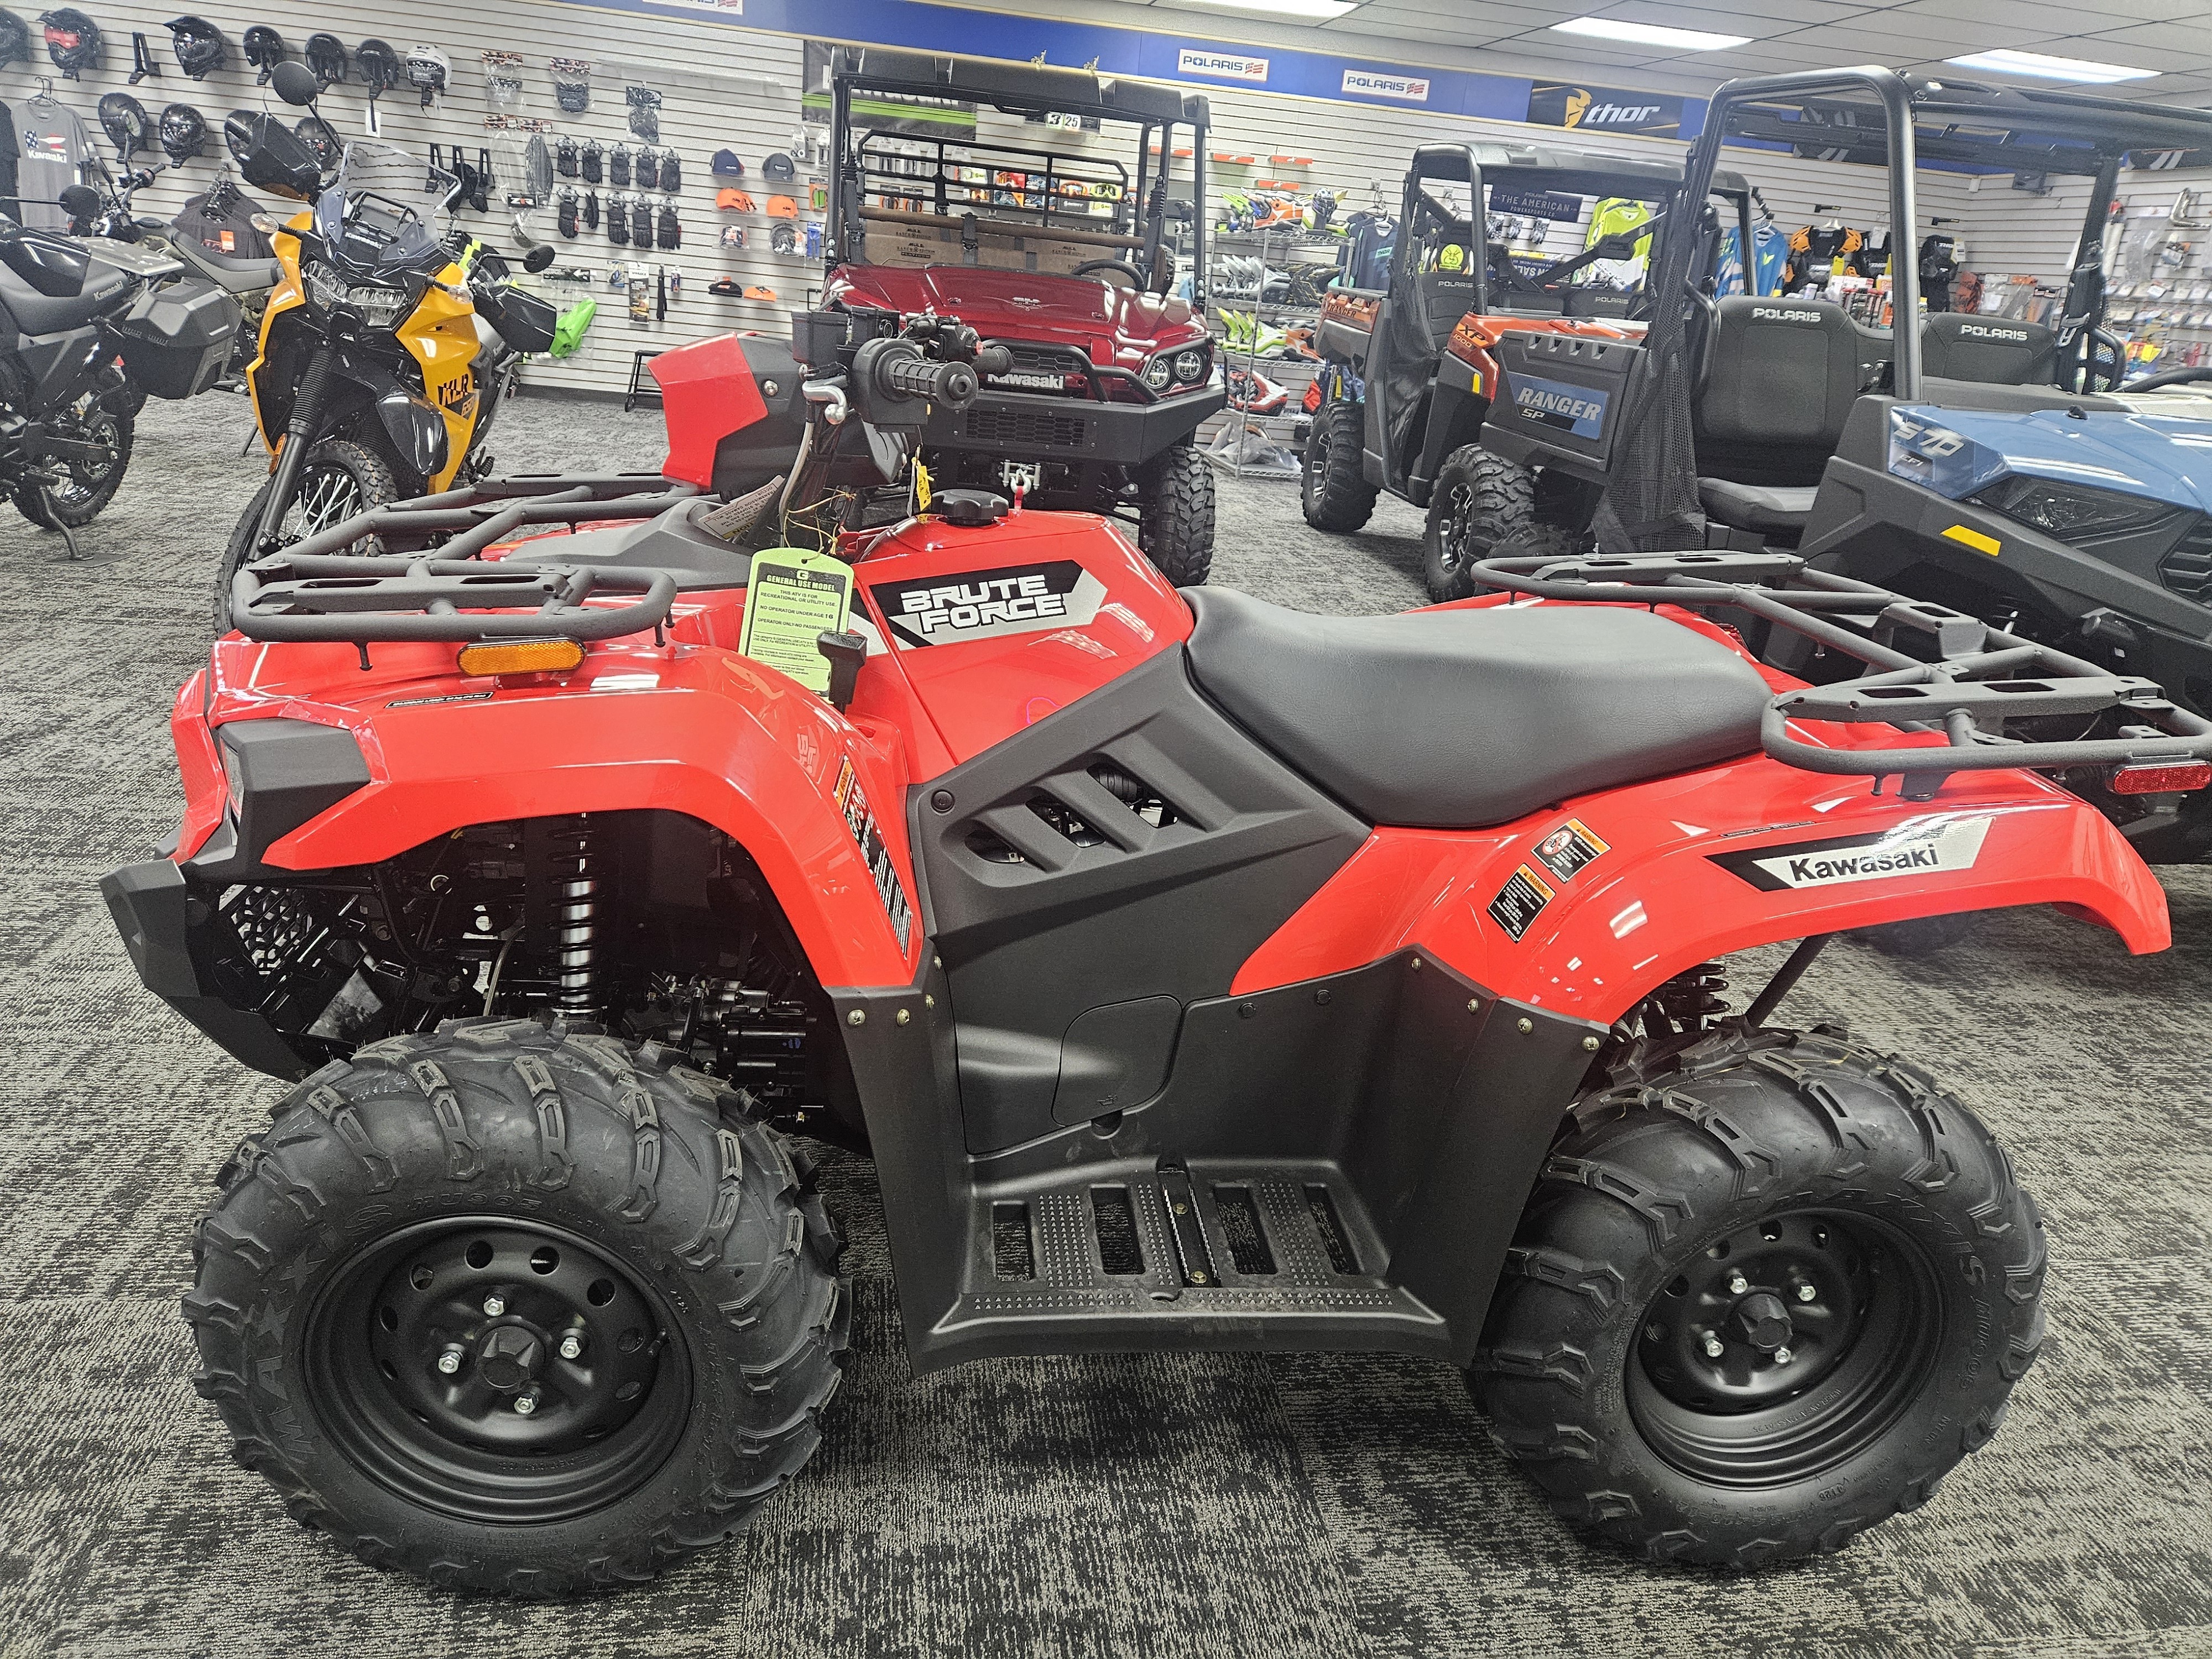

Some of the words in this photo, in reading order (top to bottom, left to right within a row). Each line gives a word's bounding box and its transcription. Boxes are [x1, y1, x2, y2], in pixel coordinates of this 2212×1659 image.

[1183, 55, 1244, 71] POLARIS
[1347, 75, 1404, 92] POLARIS
[1050, 114, 1061, 124] 3
[1585, 103, 1660, 123] thor
[1065, 116, 1078, 127] 25
[1502, 195, 1519, 204] THE
[1522, 198, 1570, 212] AMERICAN
[1511, 206, 1546, 216] POWERSPORTS
[93, 280, 124, 301] Kawasaki
[1330, 304, 1357, 318] RANGER
[1753, 307, 1821, 322] POLARIS
[1453, 333, 1472, 348] 1000
[1458, 324, 1486, 341] XP
[1961, 325, 2027, 341] POLARIS
[442, 373, 468, 406] KLR
[1517, 387, 1601, 421] RANGER
[1521, 408, 1545, 419] SP
[1893, 421, 1964, 456] 570
[1900, 454, 1924, 467] EFI
[726, 506, 743, 515] DAMAGE
[733, 506, 753, 517] STOPPED
[766, 574, 796, 586] GENERAL
[798, 580, 811, 588] USE
[812, 582, 835, 591] MODEL
[796, 570, 808, 580] G
[760, 592, 797, 602] RECREATIONAL
[900, 575, 1048, 613] BRUTE
[769, 606, 795, 614] OPERATOR
[920, 593, 1066, 634] FORCE
[1581, 831, 1598, 844] WARNING
[1790, 844, 1939, 881] Kawasaki
[1528, 874, 1548, 895] WARNING
